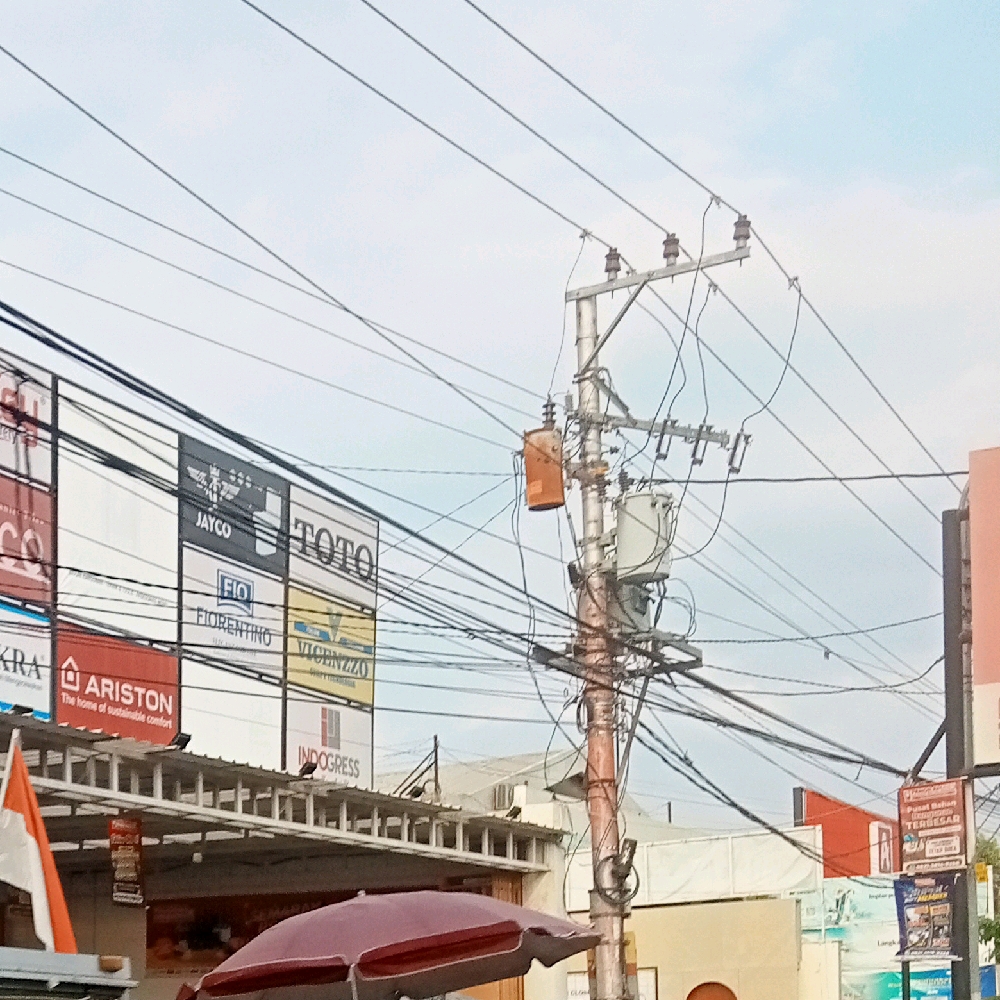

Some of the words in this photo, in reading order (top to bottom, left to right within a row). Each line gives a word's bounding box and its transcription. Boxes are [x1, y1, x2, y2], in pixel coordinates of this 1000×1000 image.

[195, 511, 232, 539] JAYCO
[294, 516, 375, 584] TOTO
[223, 577, 249, 601] FIO
[195, 605, 272, 647] FIORENTINO
[61, 691, 76, 707] The
[76, 697, 98, 713] home
[98, 703, 107, 714] of
[107, 705, 146, 723] sustainable
[146, 714, 173, 730] comfort
[84, 674, 173, 716] ARISTON
[298, 745, 361, 780] INDOGRESS
